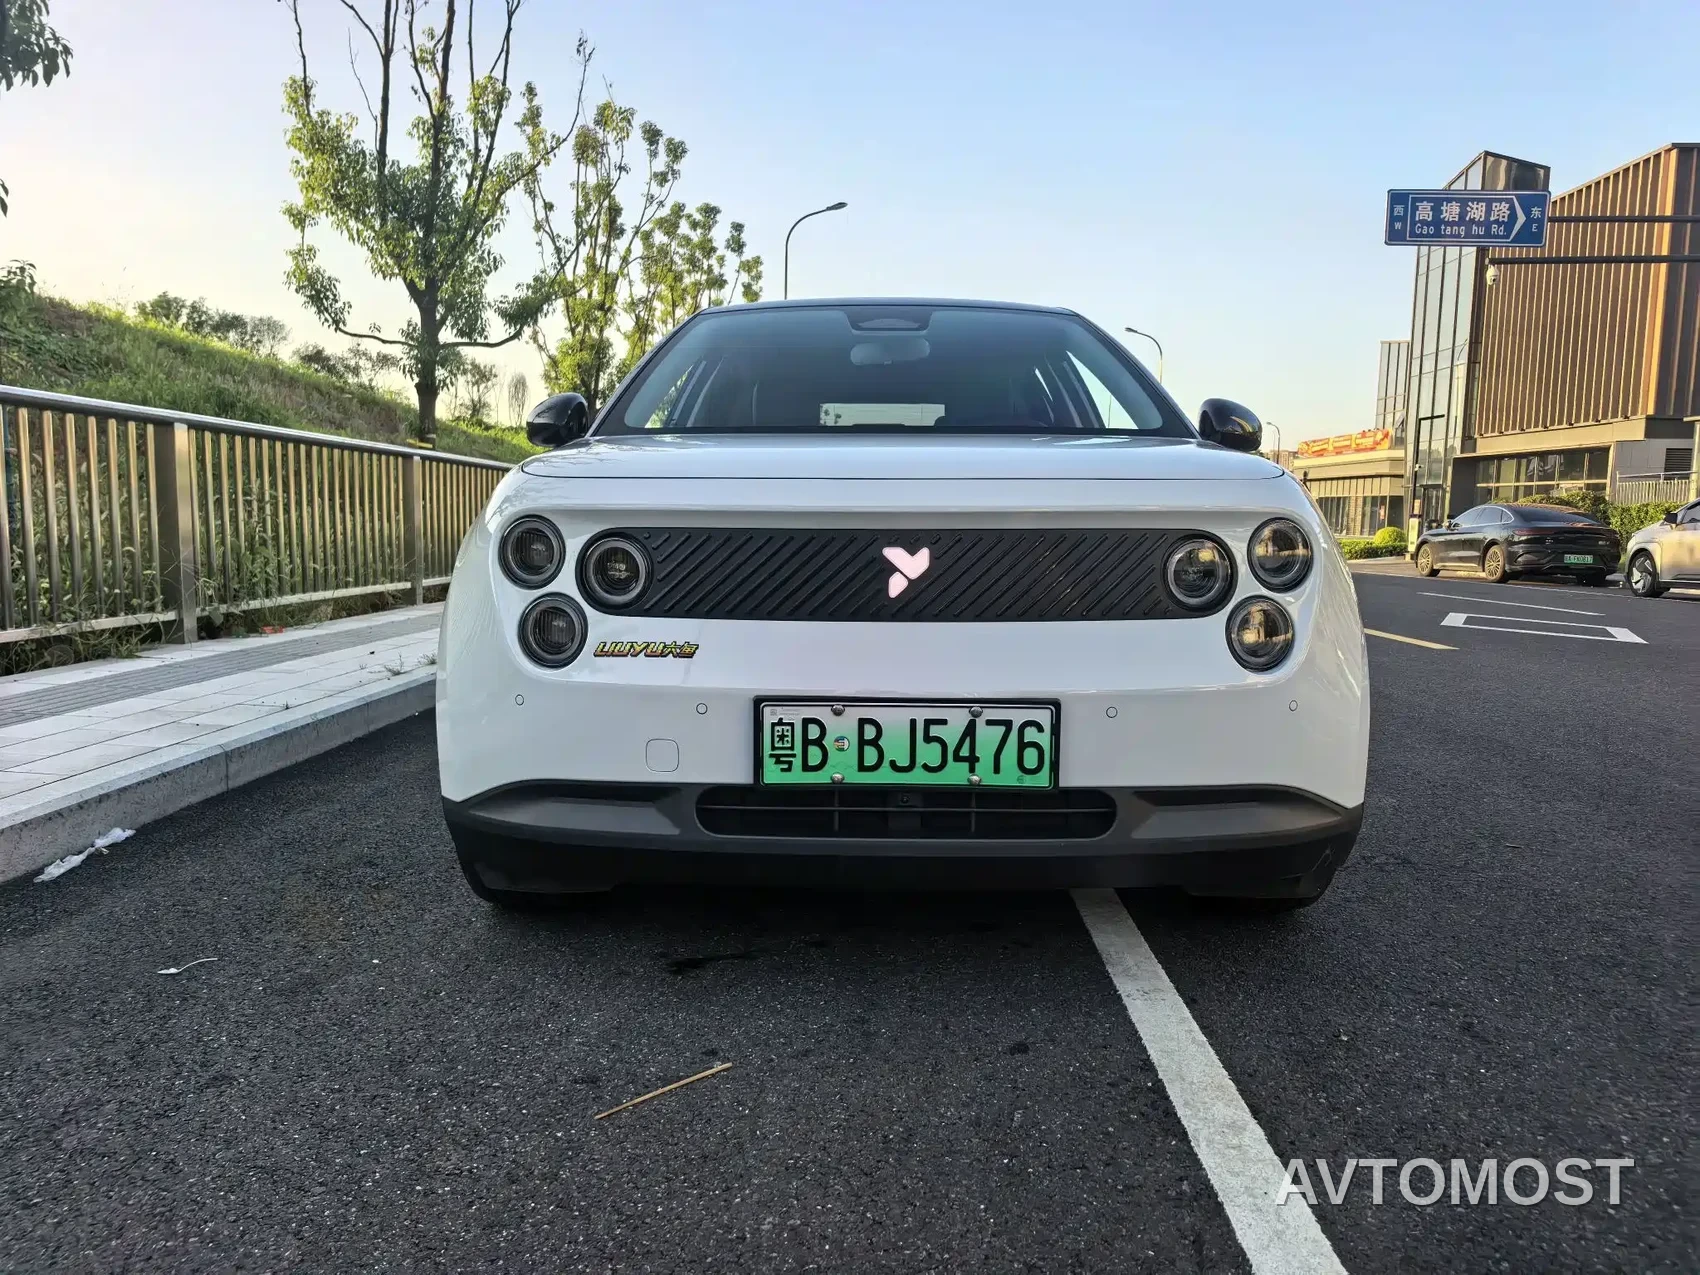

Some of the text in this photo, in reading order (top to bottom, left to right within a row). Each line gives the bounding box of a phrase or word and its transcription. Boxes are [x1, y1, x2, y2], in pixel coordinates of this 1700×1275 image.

[1393, 204, 1404, 216] 西
[1415, 201, 1510, 222] 高塘湖路
[1530, 206, 1542, 219] 东
[1394, 222, 1402, 230] W
[1415, 223, 1507, 238] Gao tang hu Rd.
[1531, 223, 1539, 232] E
